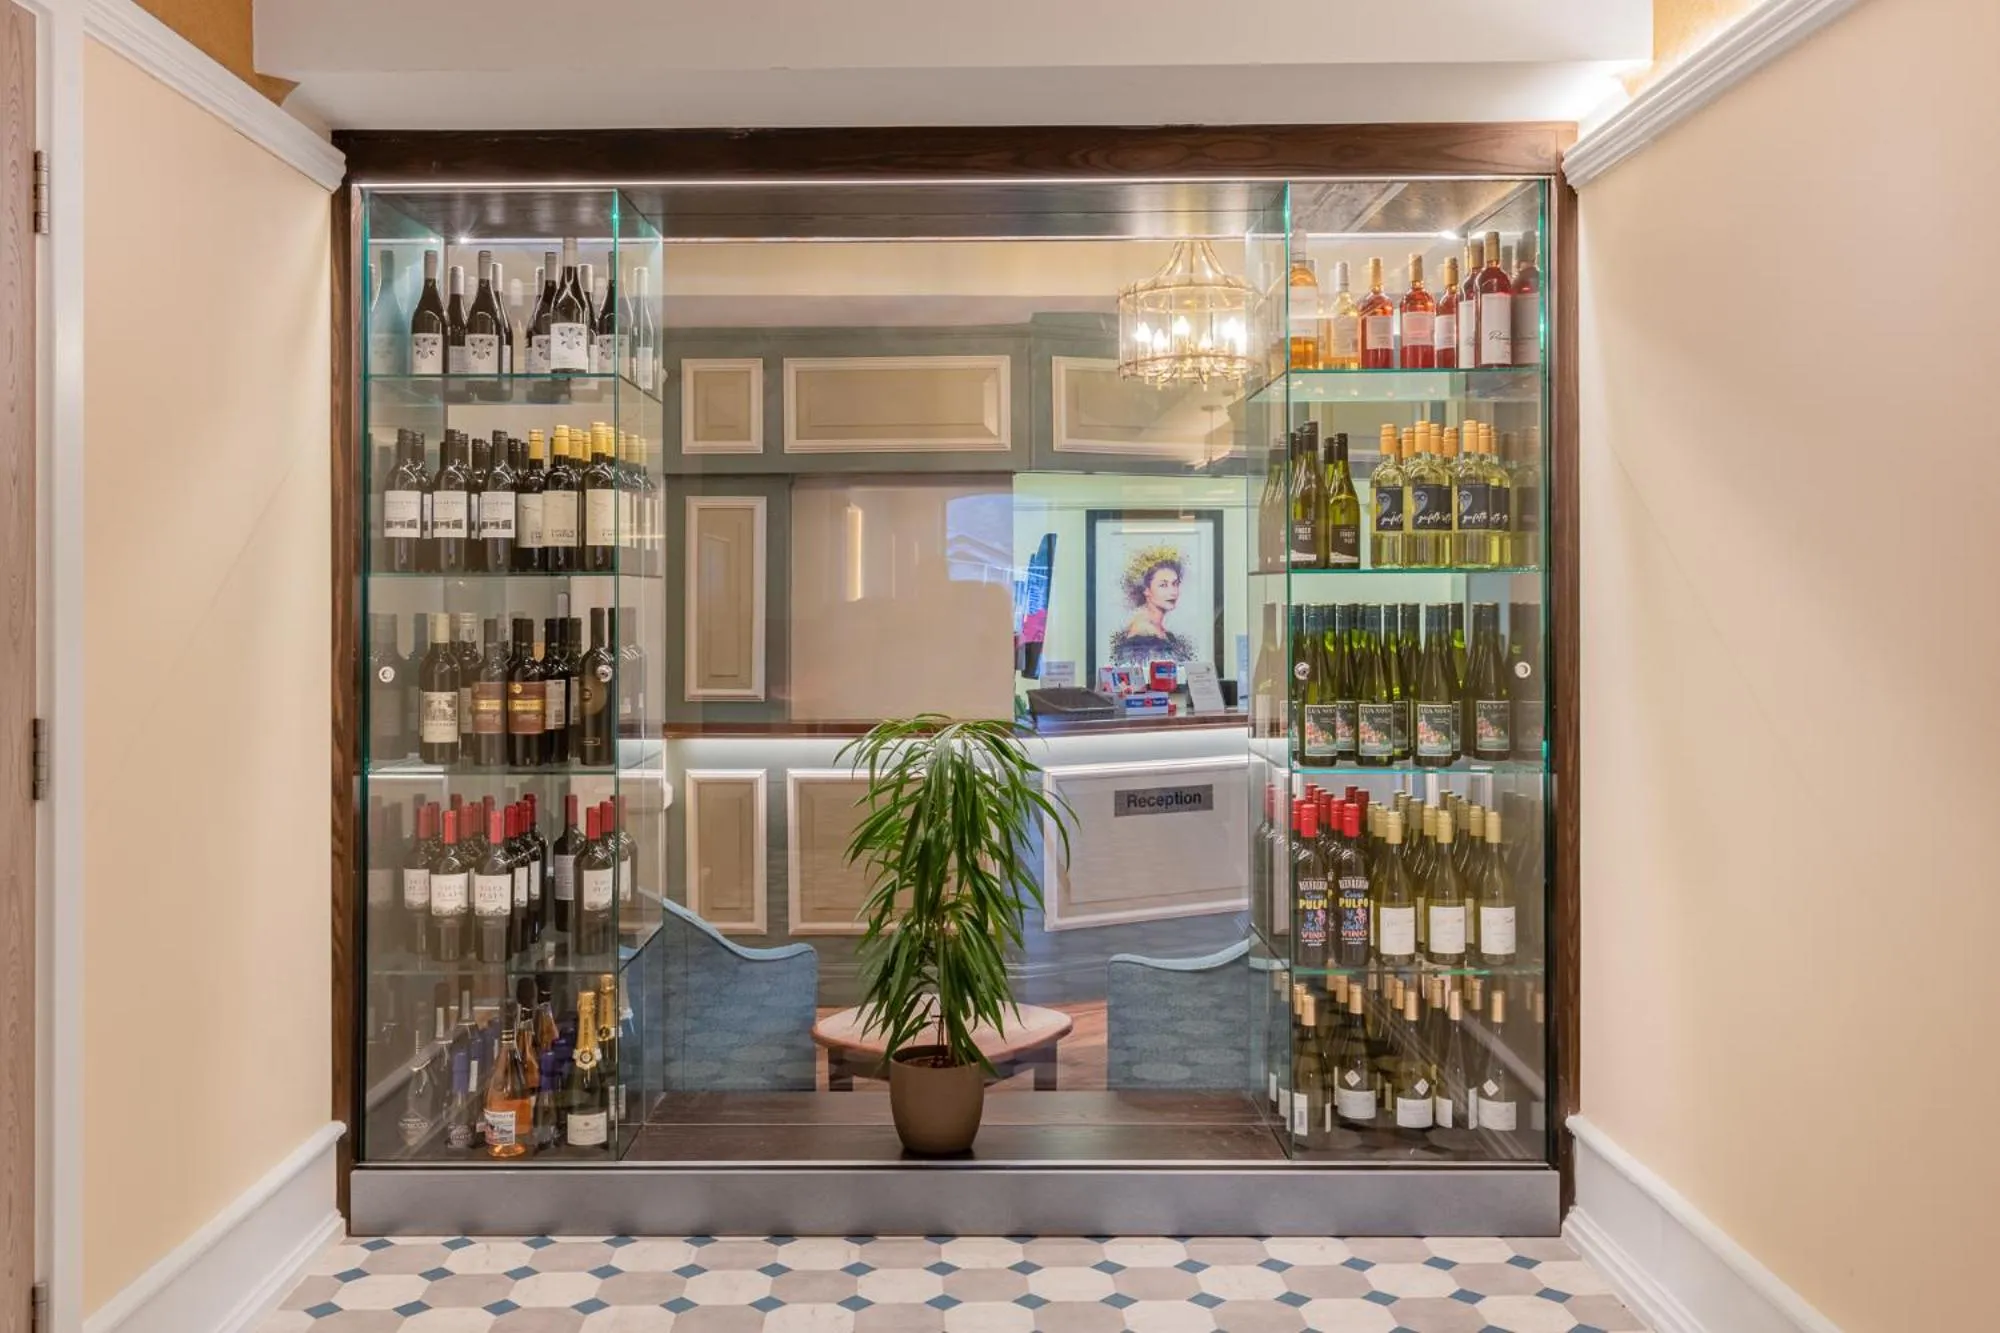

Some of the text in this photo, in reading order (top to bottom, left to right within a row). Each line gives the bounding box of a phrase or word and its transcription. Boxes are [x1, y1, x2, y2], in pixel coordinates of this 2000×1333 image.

[1126, 791, 1202, 810] Reception
[1338, 897, 1369, 908] PULPO
[1301, 930, 1327, 940] VINO
[1341, 929, 1368, 938] VINO
